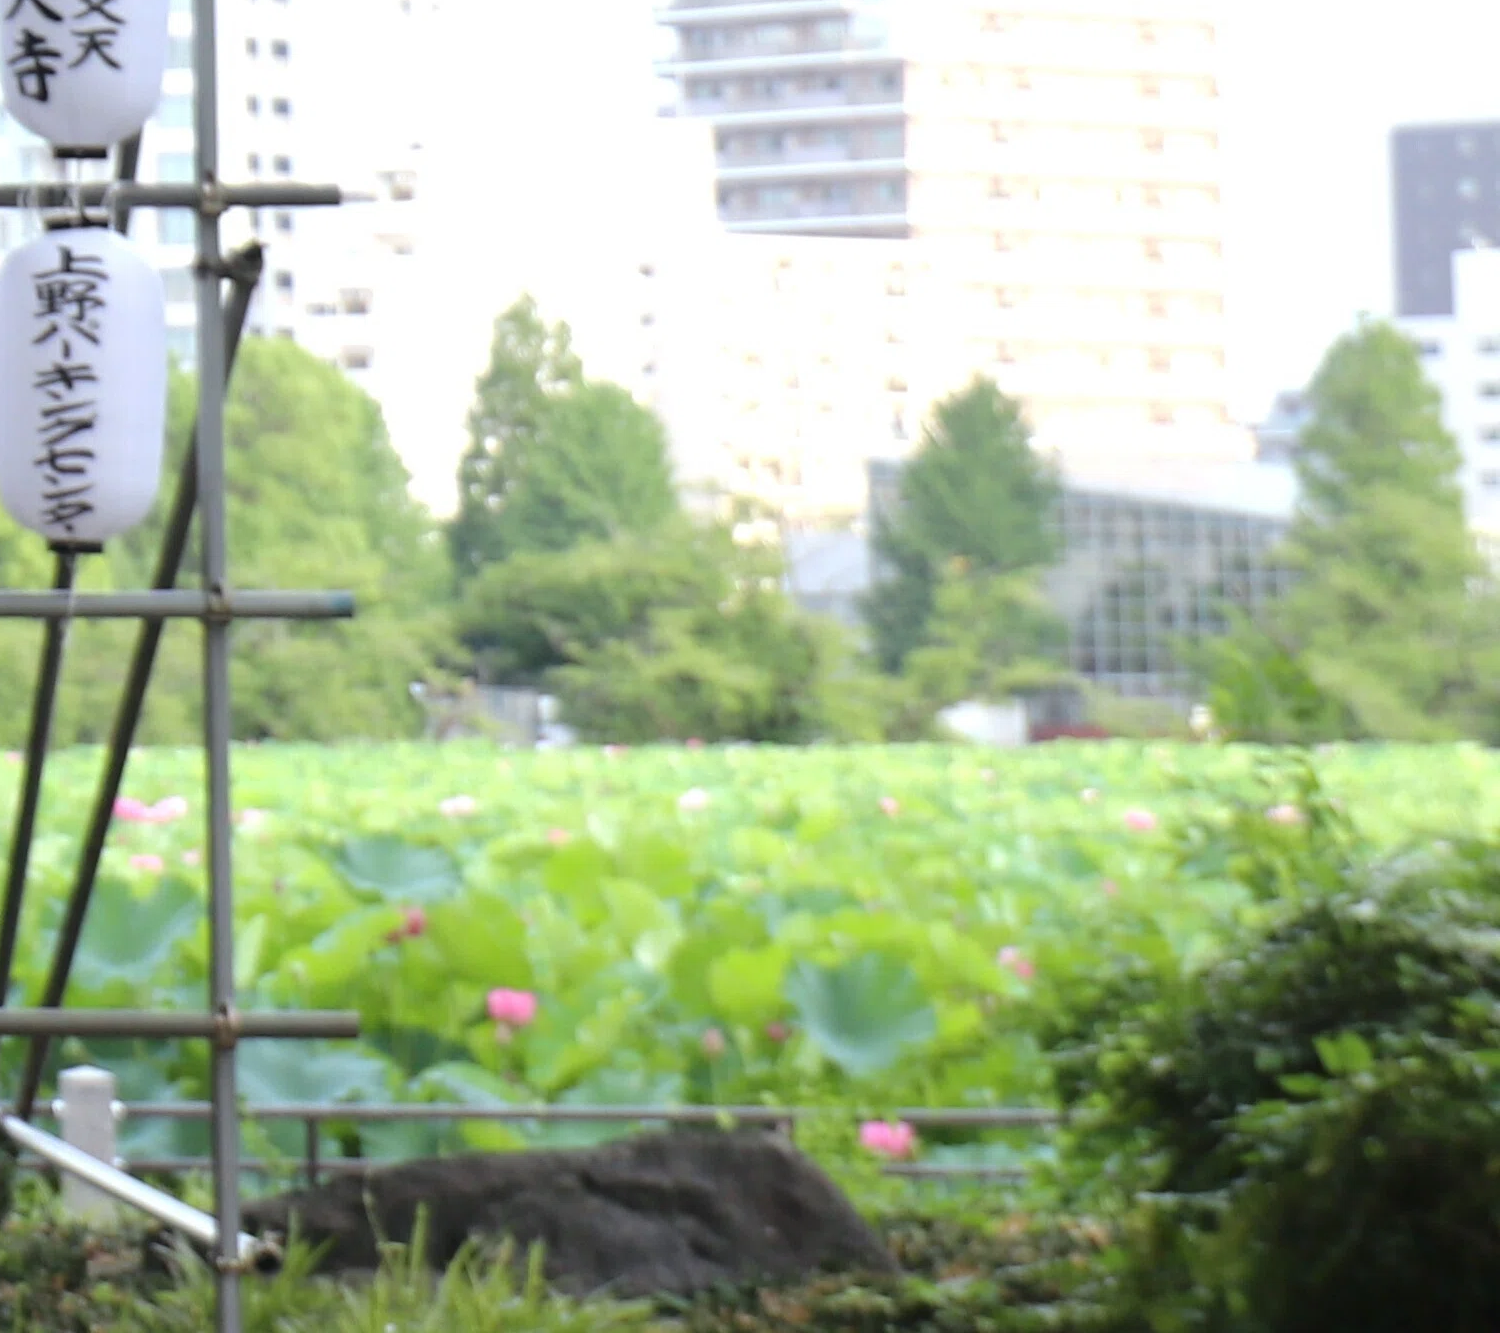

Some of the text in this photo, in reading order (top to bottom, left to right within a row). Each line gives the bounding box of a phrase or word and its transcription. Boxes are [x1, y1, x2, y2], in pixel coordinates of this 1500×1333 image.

[34, 247, 108, 533] 上野パーキングセンター
